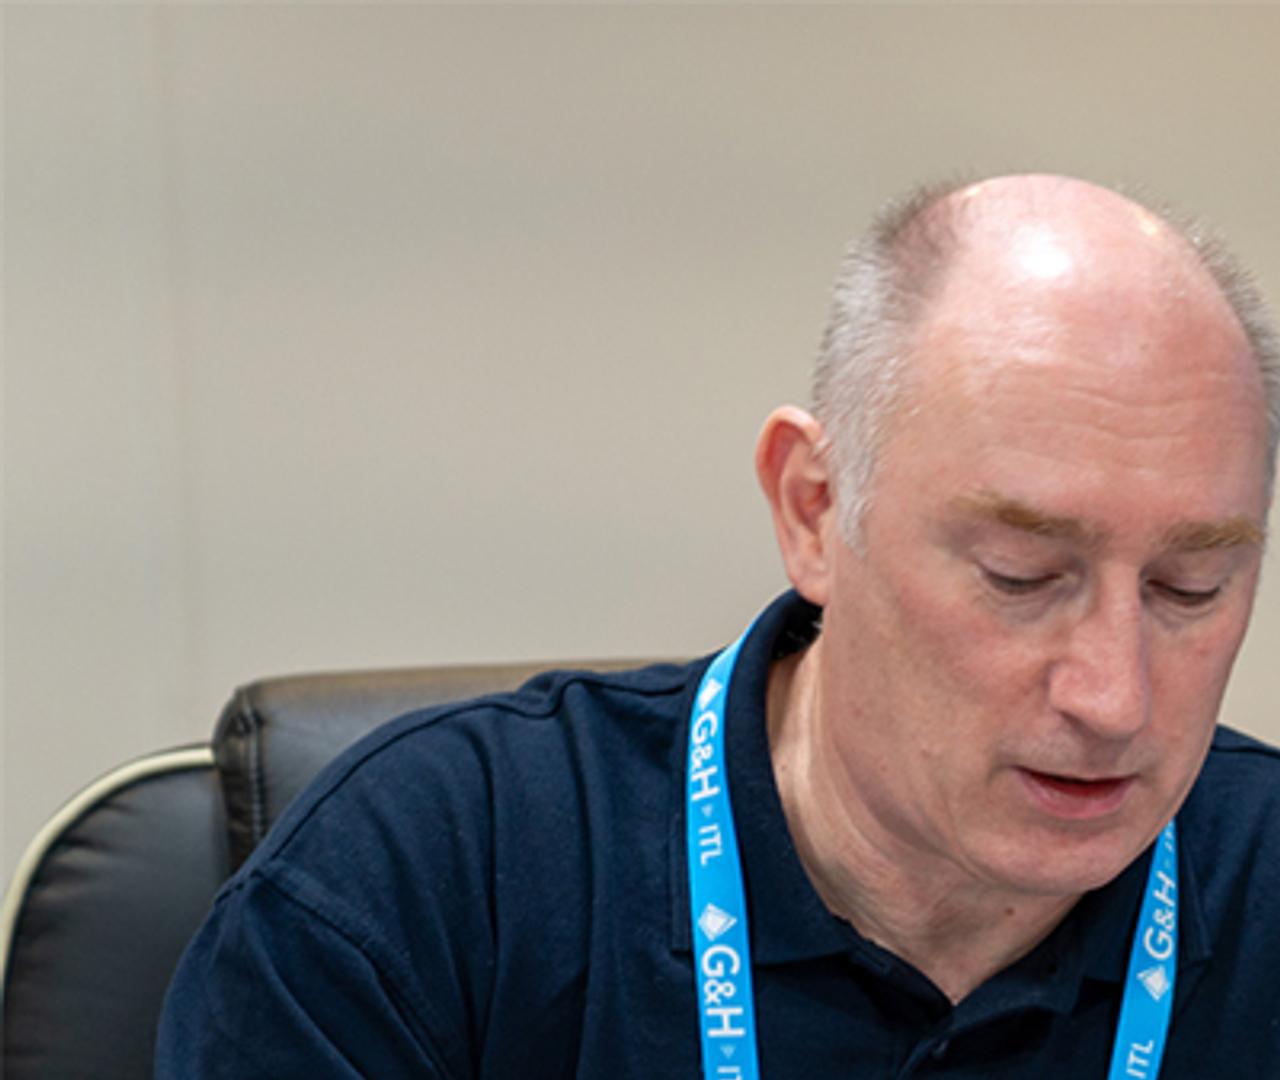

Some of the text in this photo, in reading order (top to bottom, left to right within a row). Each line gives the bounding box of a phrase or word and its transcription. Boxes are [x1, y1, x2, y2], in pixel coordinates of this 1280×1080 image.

[691, 709, 722, 867] G&H ITL
[1143, 870, 1176, 961] G&H
[701, 944, 746, 1038] G&H
[1126, 1039, 1155, 1080] ITL
